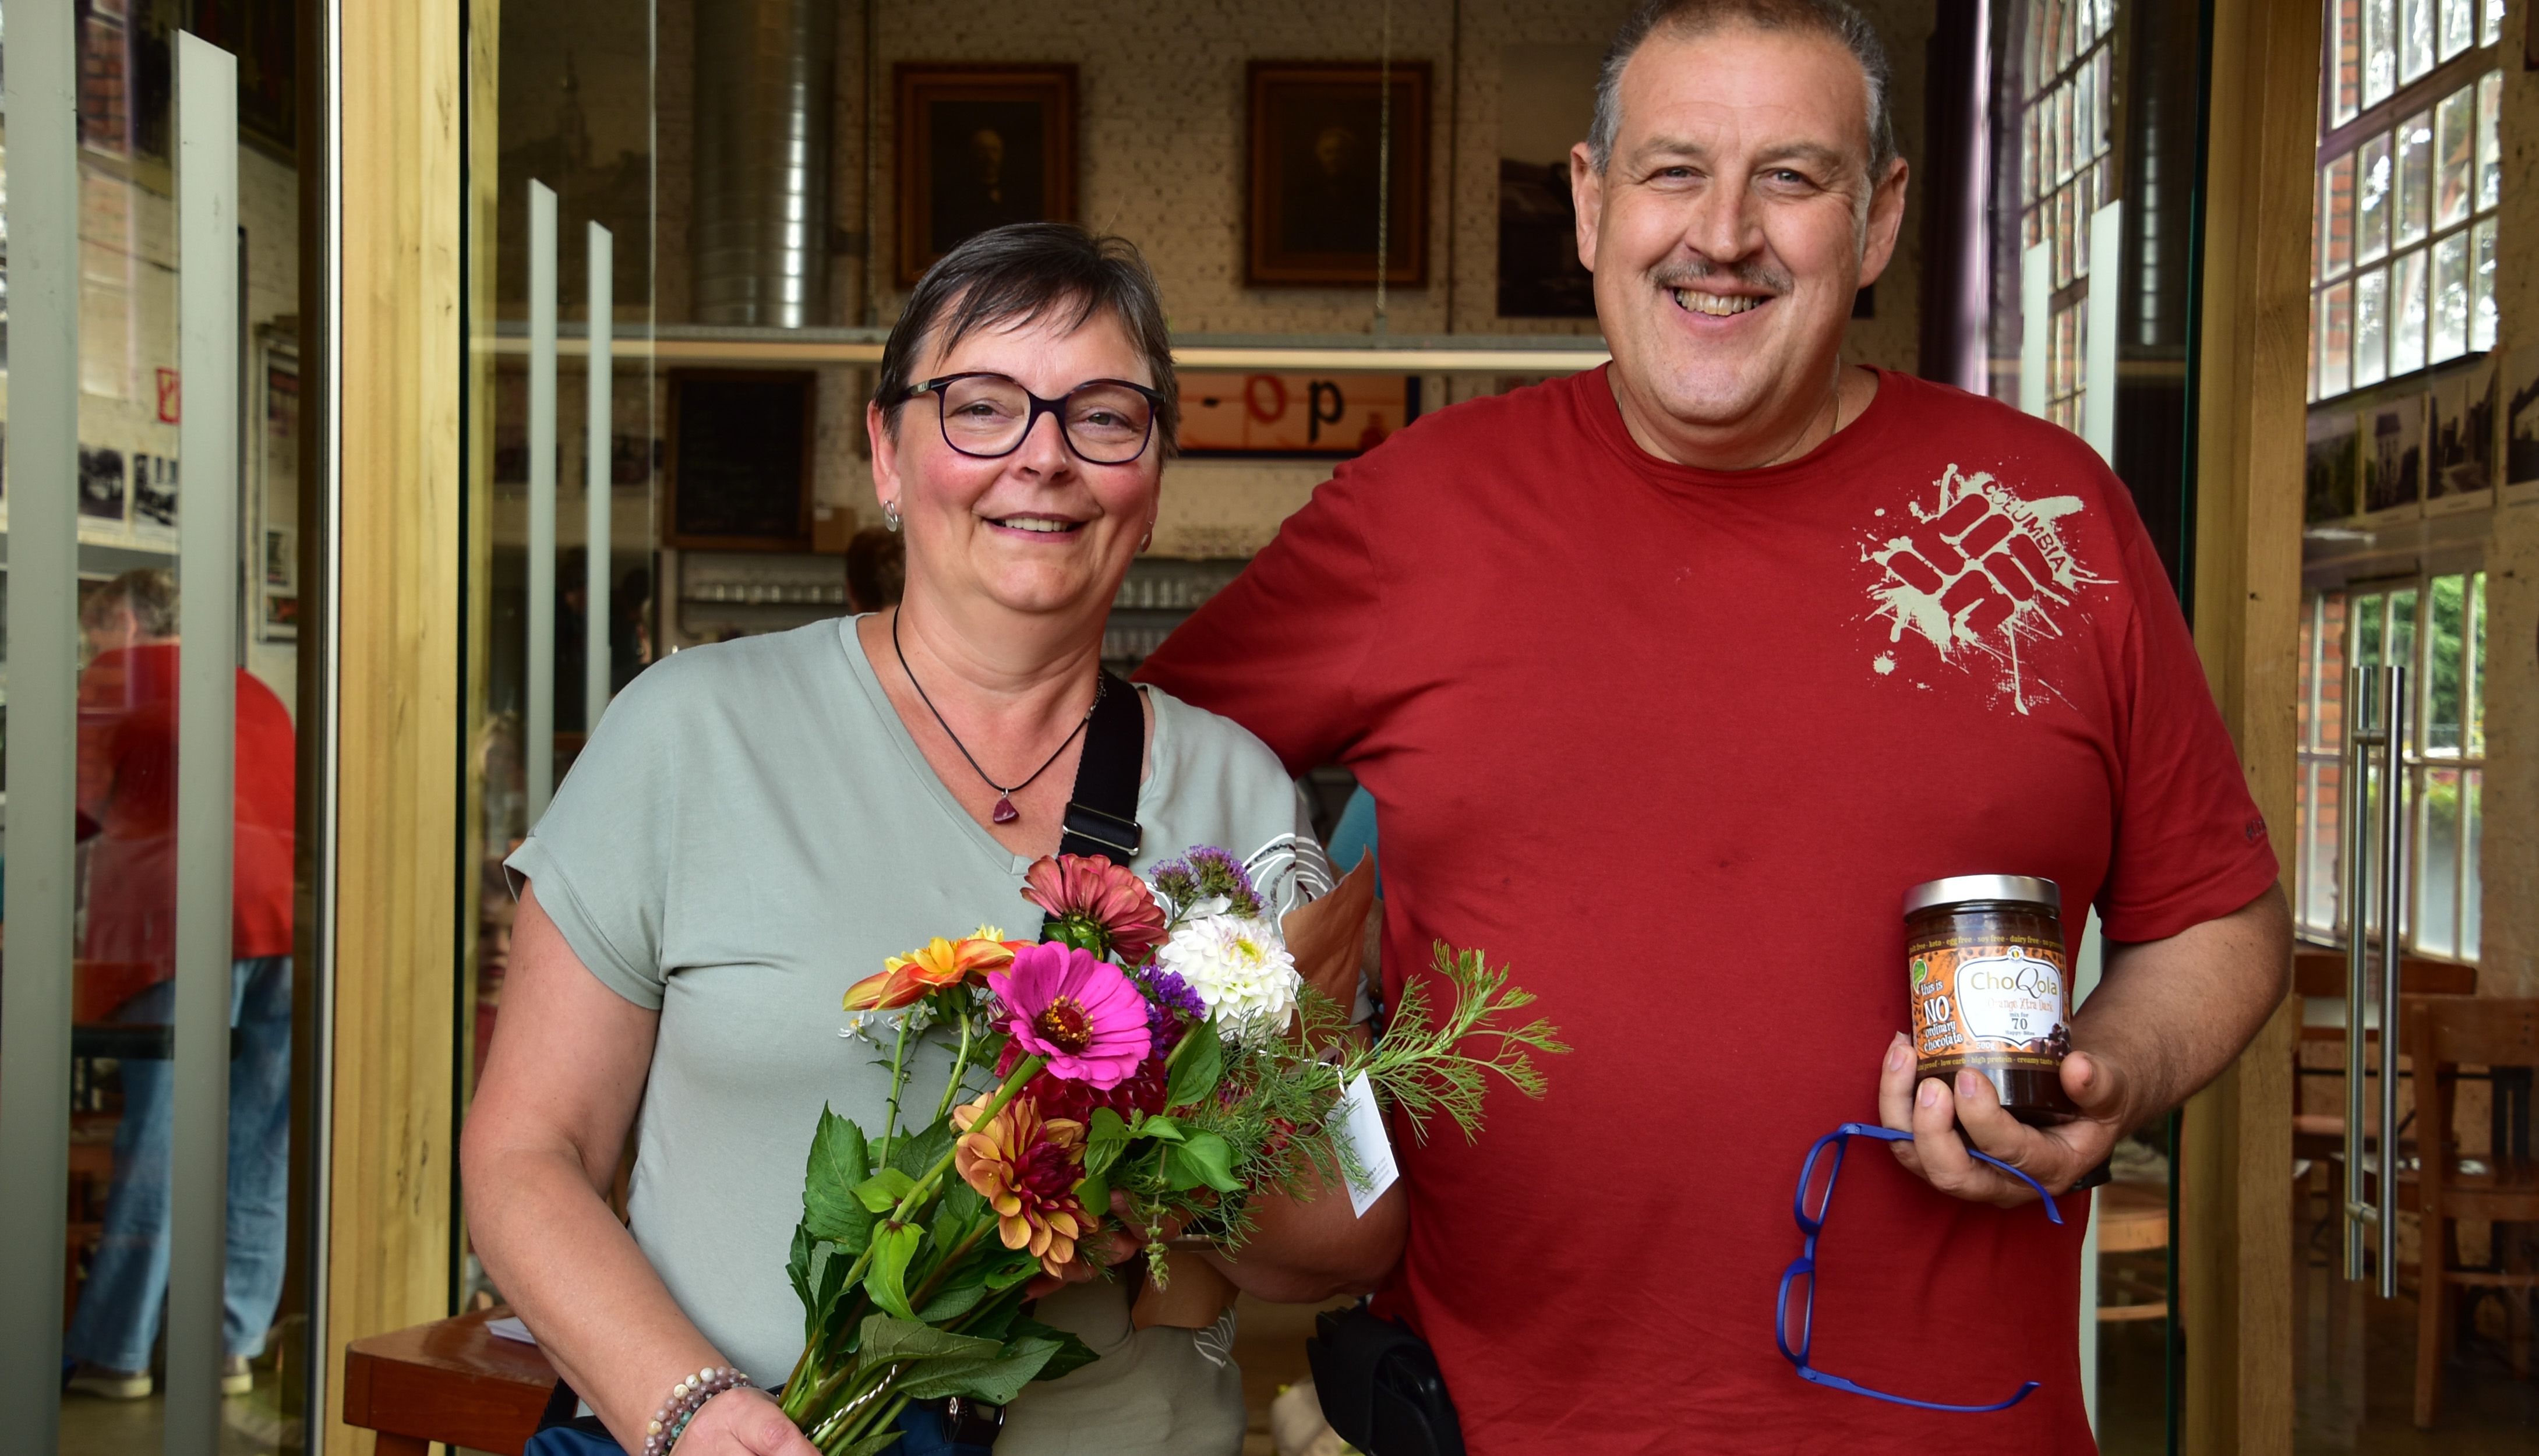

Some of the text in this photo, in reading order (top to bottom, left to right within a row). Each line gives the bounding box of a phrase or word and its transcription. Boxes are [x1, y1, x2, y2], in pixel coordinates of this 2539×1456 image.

[1982, 481, 2066, 573] COLUMBIA
[2010, 935, 2026, 944] dairy
[2027, 935, 2039, 943] free
[1921, 980, 1943, 996] this is
[1971, 967, 2058, 999] ChoQola
[1924, 995, 1950, 1026] NO
[1925, 1020, 1956, 1038] ordinary
[2011, 1018, 2028, 1030] 70
[1924, 1033, 1964, 1052] chocolate
[1971, 1056, 1986, 1065] high
[1987, 1055, 2012, 1064] protein
[2017, 1057, 2039, 1065] creamy
